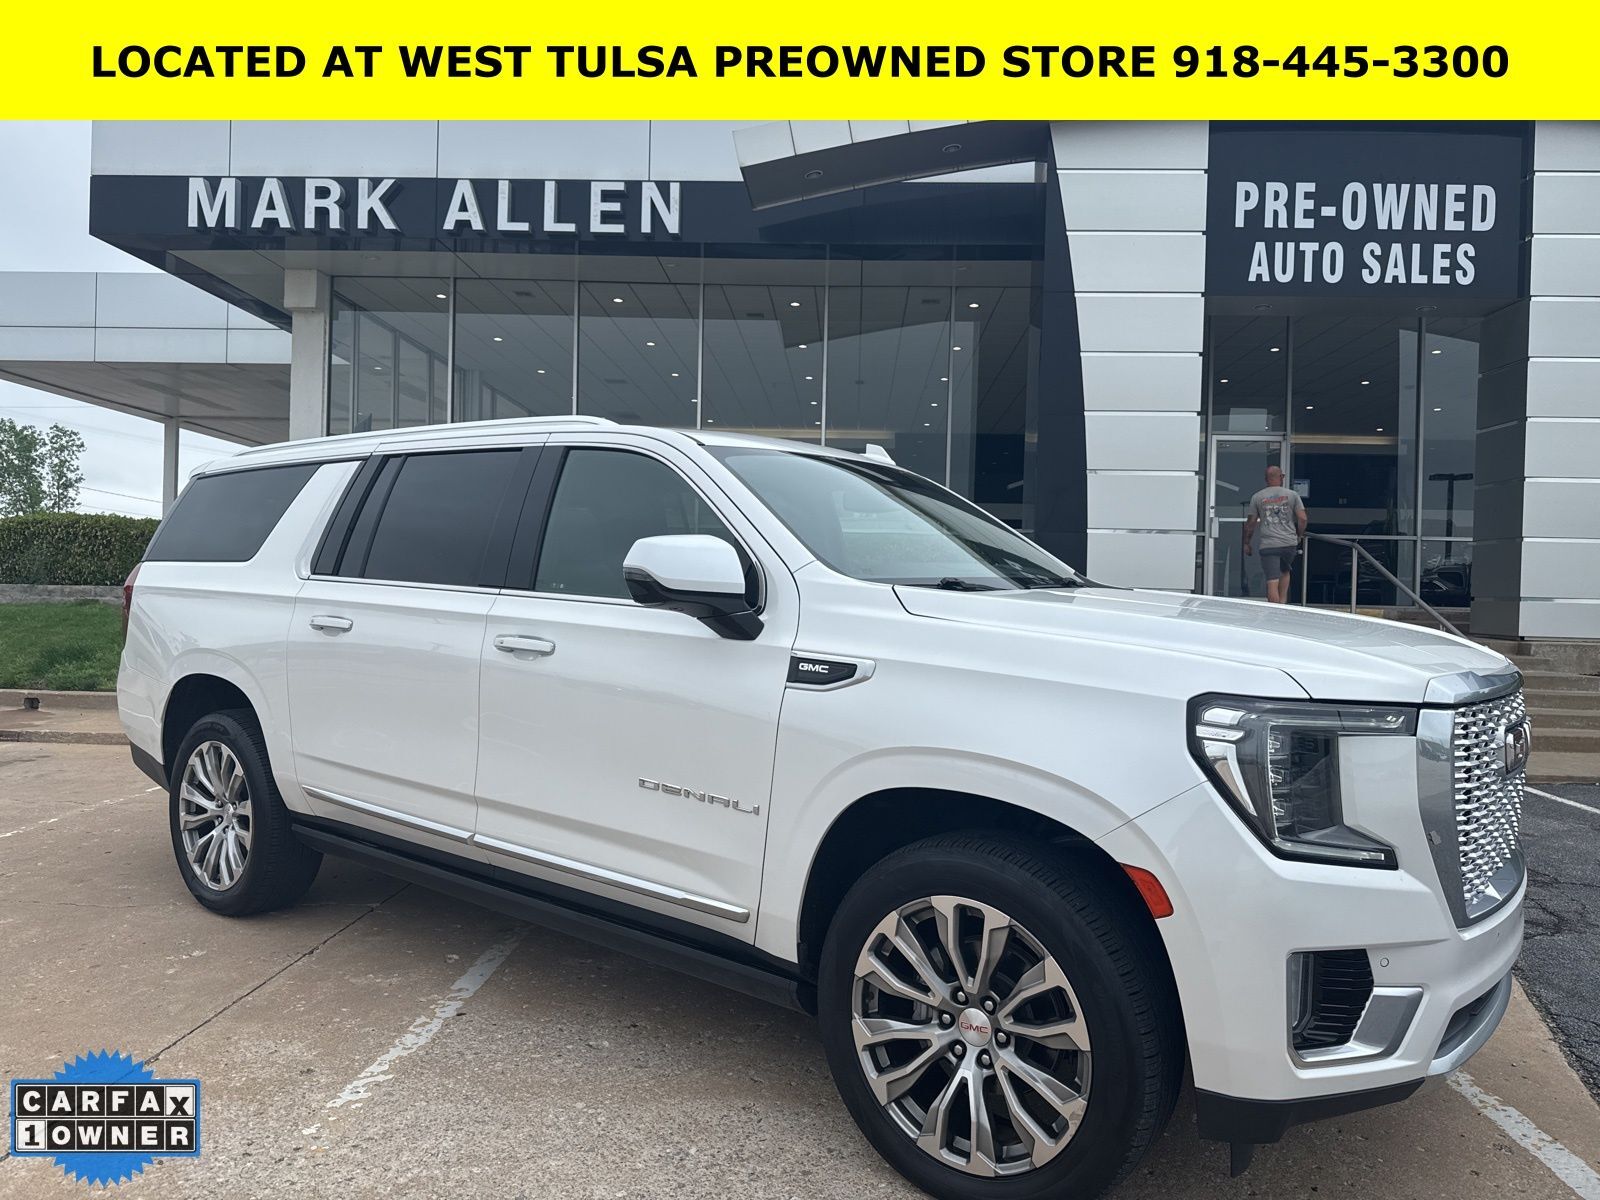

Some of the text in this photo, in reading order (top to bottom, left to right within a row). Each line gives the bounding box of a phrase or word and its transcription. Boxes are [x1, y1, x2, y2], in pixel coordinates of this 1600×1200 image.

[187, 177, 682, 235] MARK ALLEN
[1235, 181, 1497, 232] PRE-OWNED
[1248, 241, 1476, 285] AUTO SALES
[798, 662, 829, 674] GMC
[638, 777, 760, 816] DENALI
[960, 1021, 988, 1034] GMC
